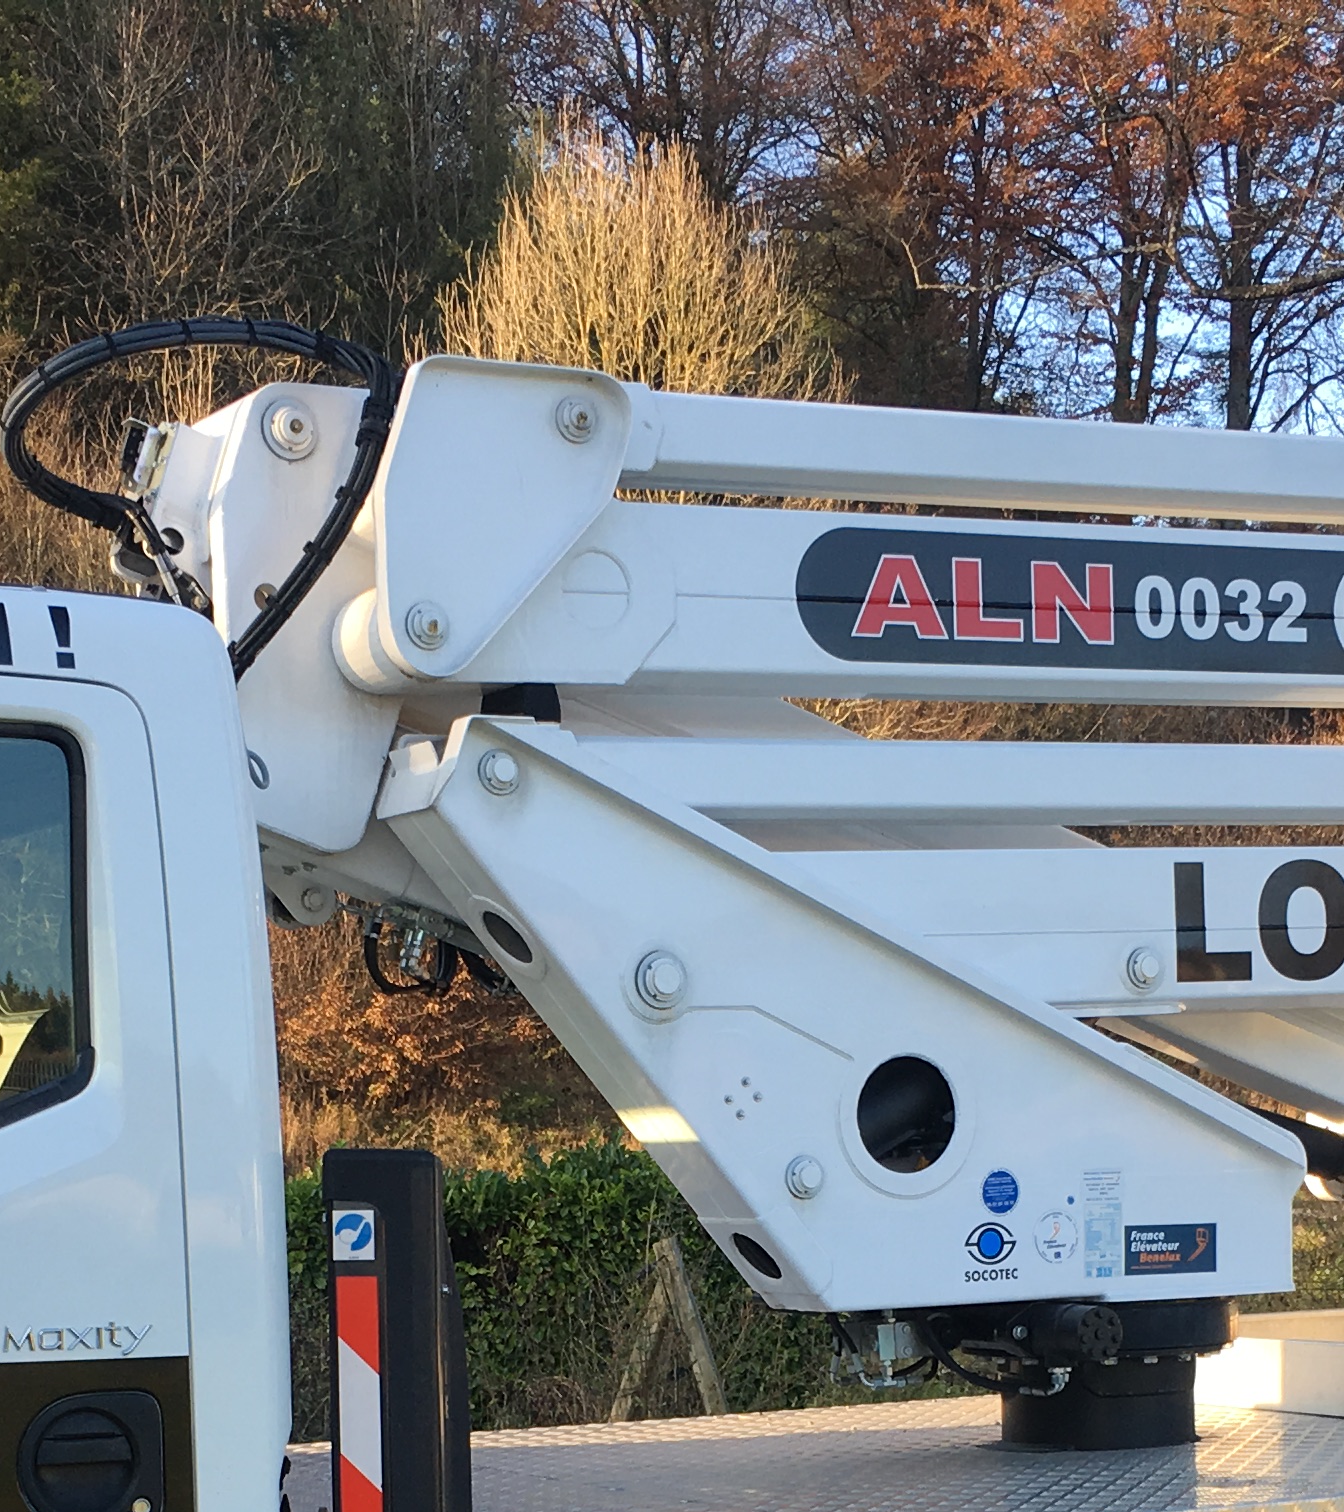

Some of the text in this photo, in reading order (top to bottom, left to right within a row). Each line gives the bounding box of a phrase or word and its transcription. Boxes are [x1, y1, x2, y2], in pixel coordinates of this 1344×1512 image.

[851, 553, 1115, 646] ALN
[1134, 574, 1309, 643] 0032
[48, 604, 77, 670] !
[964, 1267, 1019, 1283] SOCOTEC
[2, 1321, 154, 1356] Maxity
